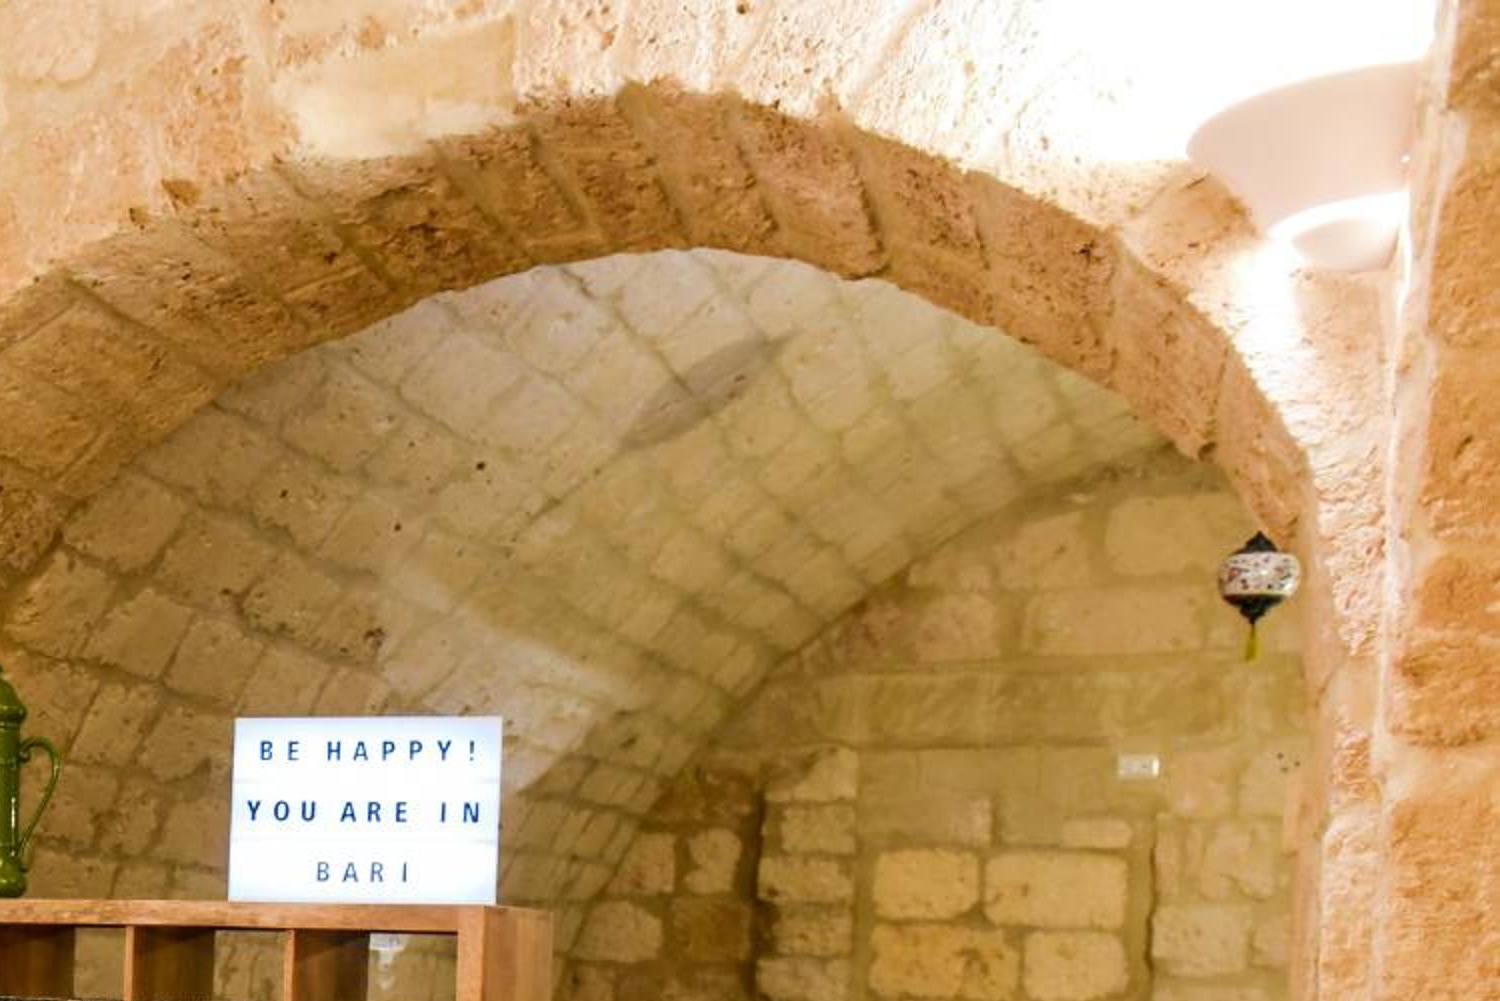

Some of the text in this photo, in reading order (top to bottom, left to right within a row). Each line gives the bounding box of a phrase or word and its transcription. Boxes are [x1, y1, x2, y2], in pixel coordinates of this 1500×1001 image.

[260, 740, 474, 761] BE HAPPY!
[247, 800, 479, 823] YOU ARE IN
[317, 862, 406, 882] BARI
